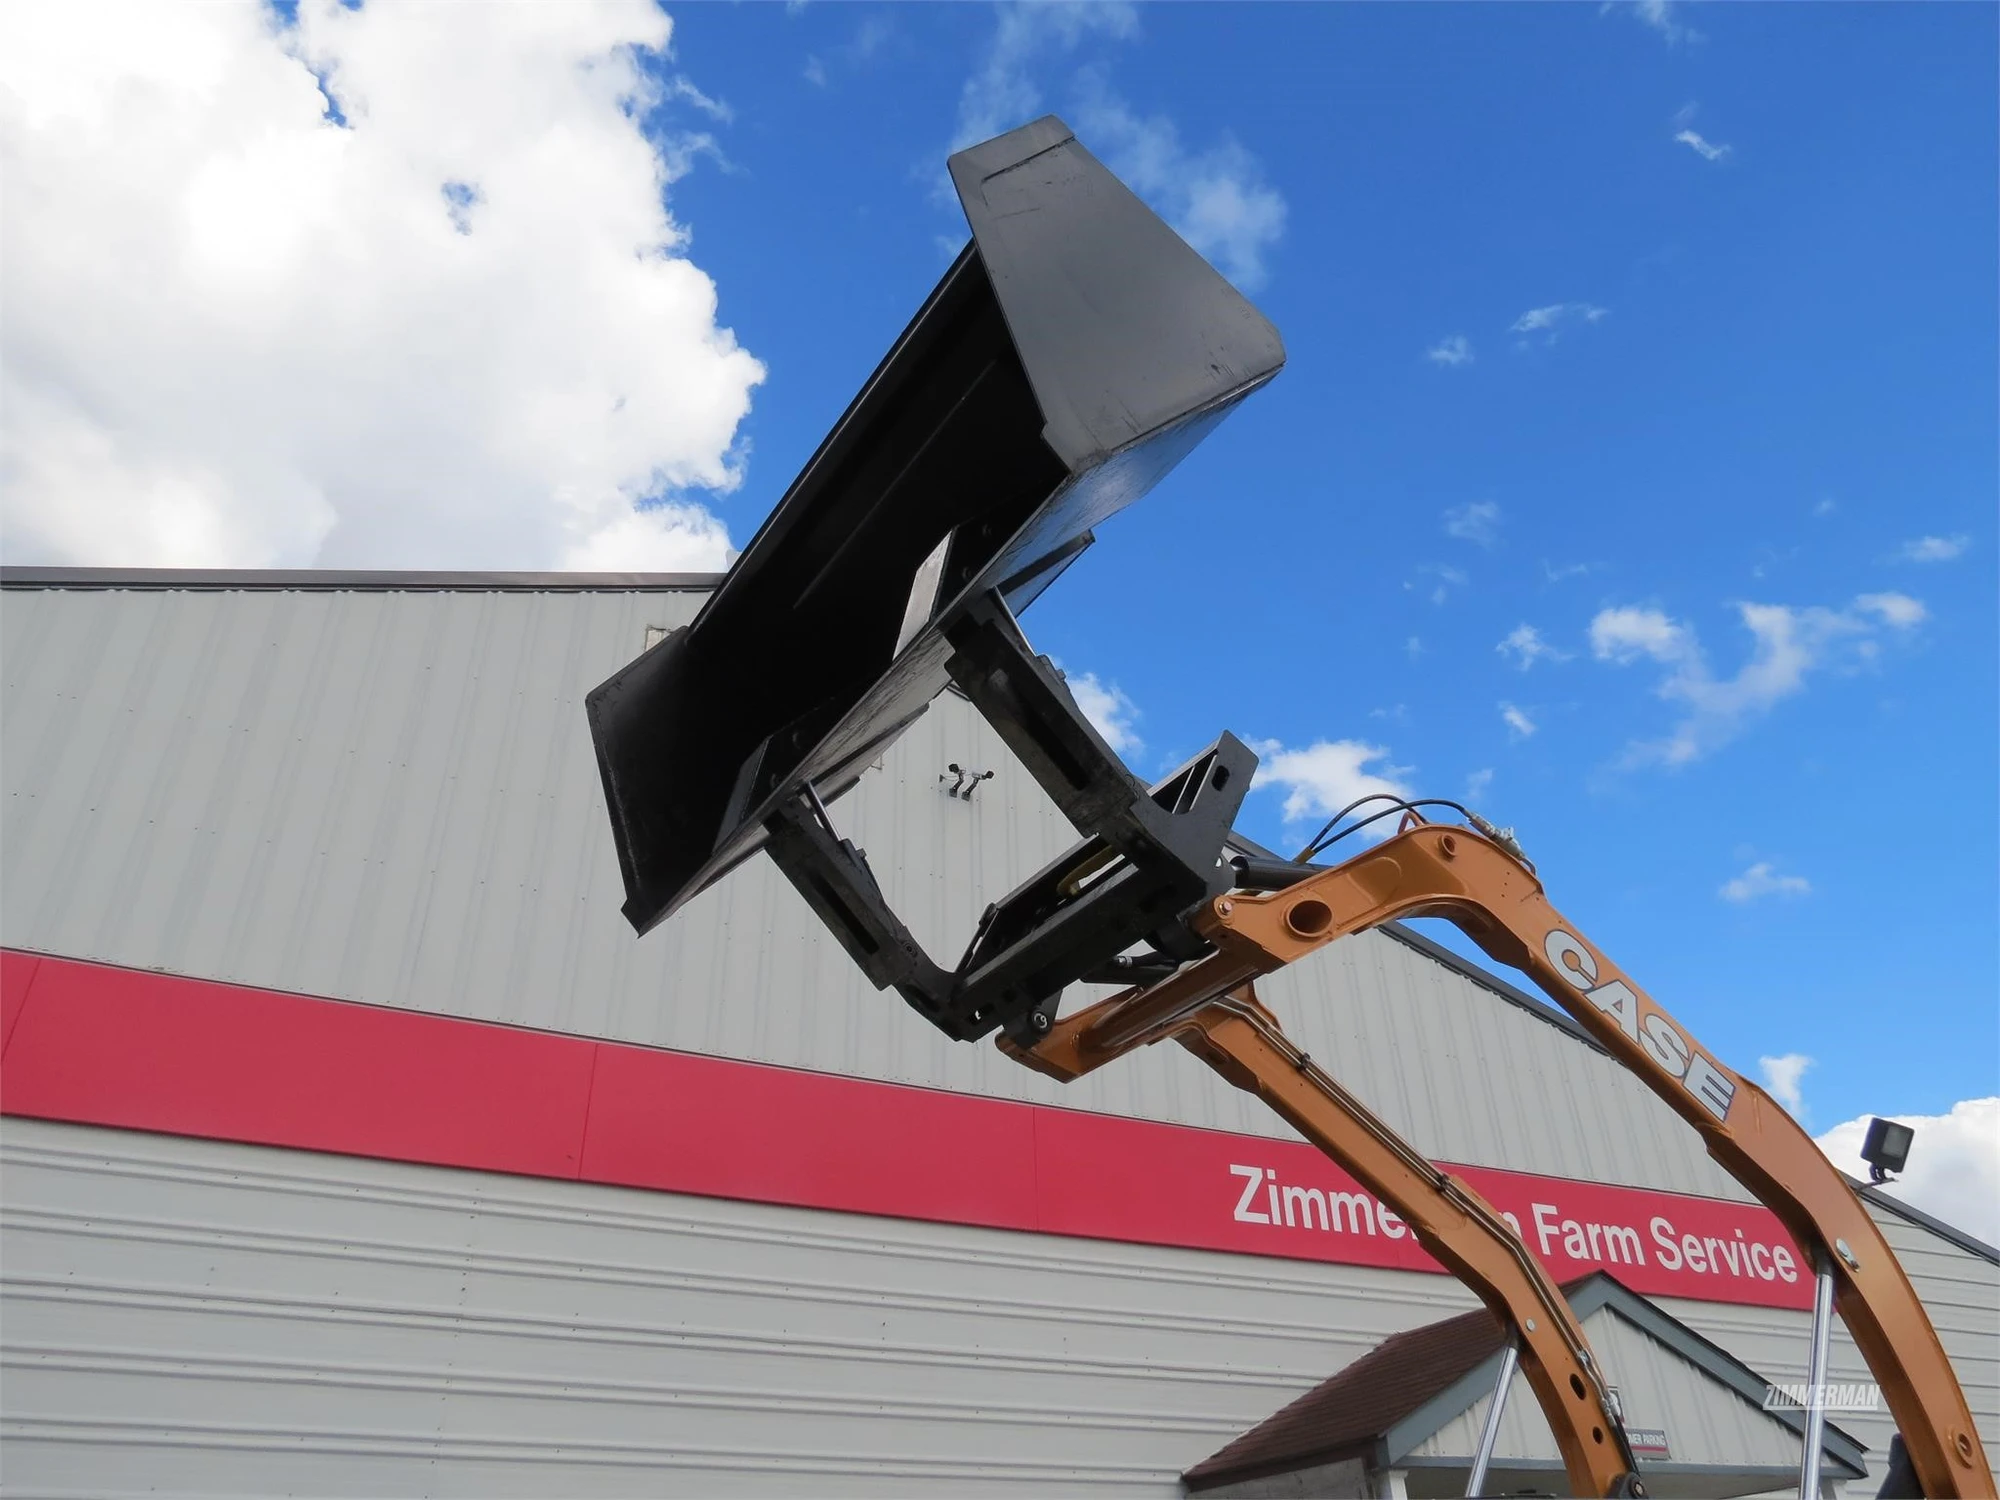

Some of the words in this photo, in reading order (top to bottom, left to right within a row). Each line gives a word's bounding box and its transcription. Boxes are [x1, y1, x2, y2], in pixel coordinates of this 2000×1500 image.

[1544, 928, 1737, 1123] CASE
[1531, 1202, 1646, 1266] Farm
[1650, 1216, 1798, 1283] Service
